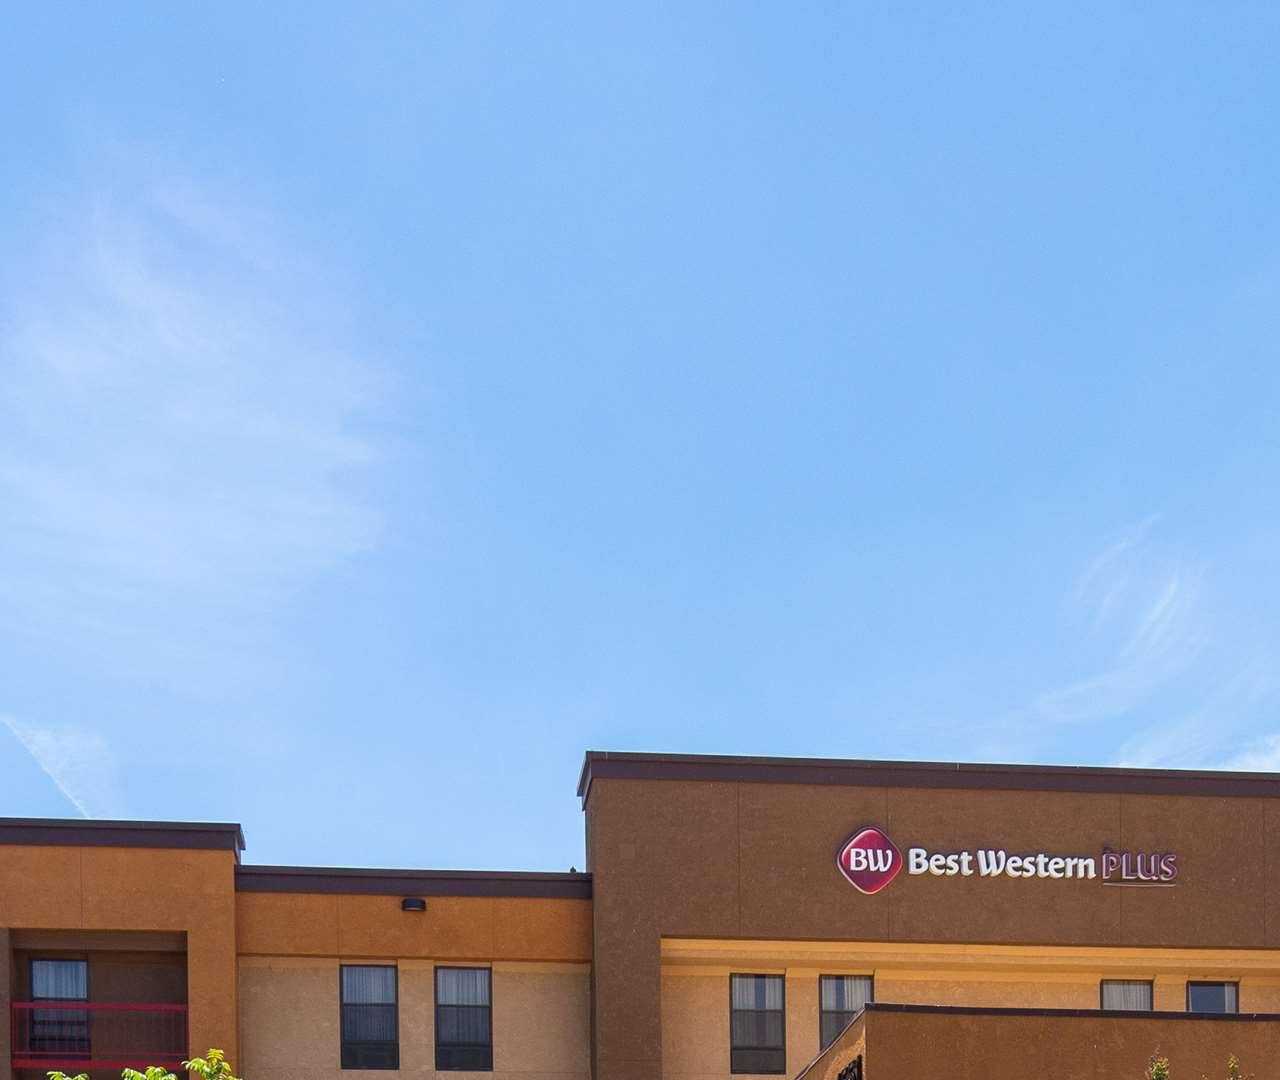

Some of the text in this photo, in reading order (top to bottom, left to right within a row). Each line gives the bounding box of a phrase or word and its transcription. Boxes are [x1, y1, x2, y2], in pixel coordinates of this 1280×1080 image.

[850, 848, 892, 872] BW
[908, 848, 1178, 881] Best Western PLUS
